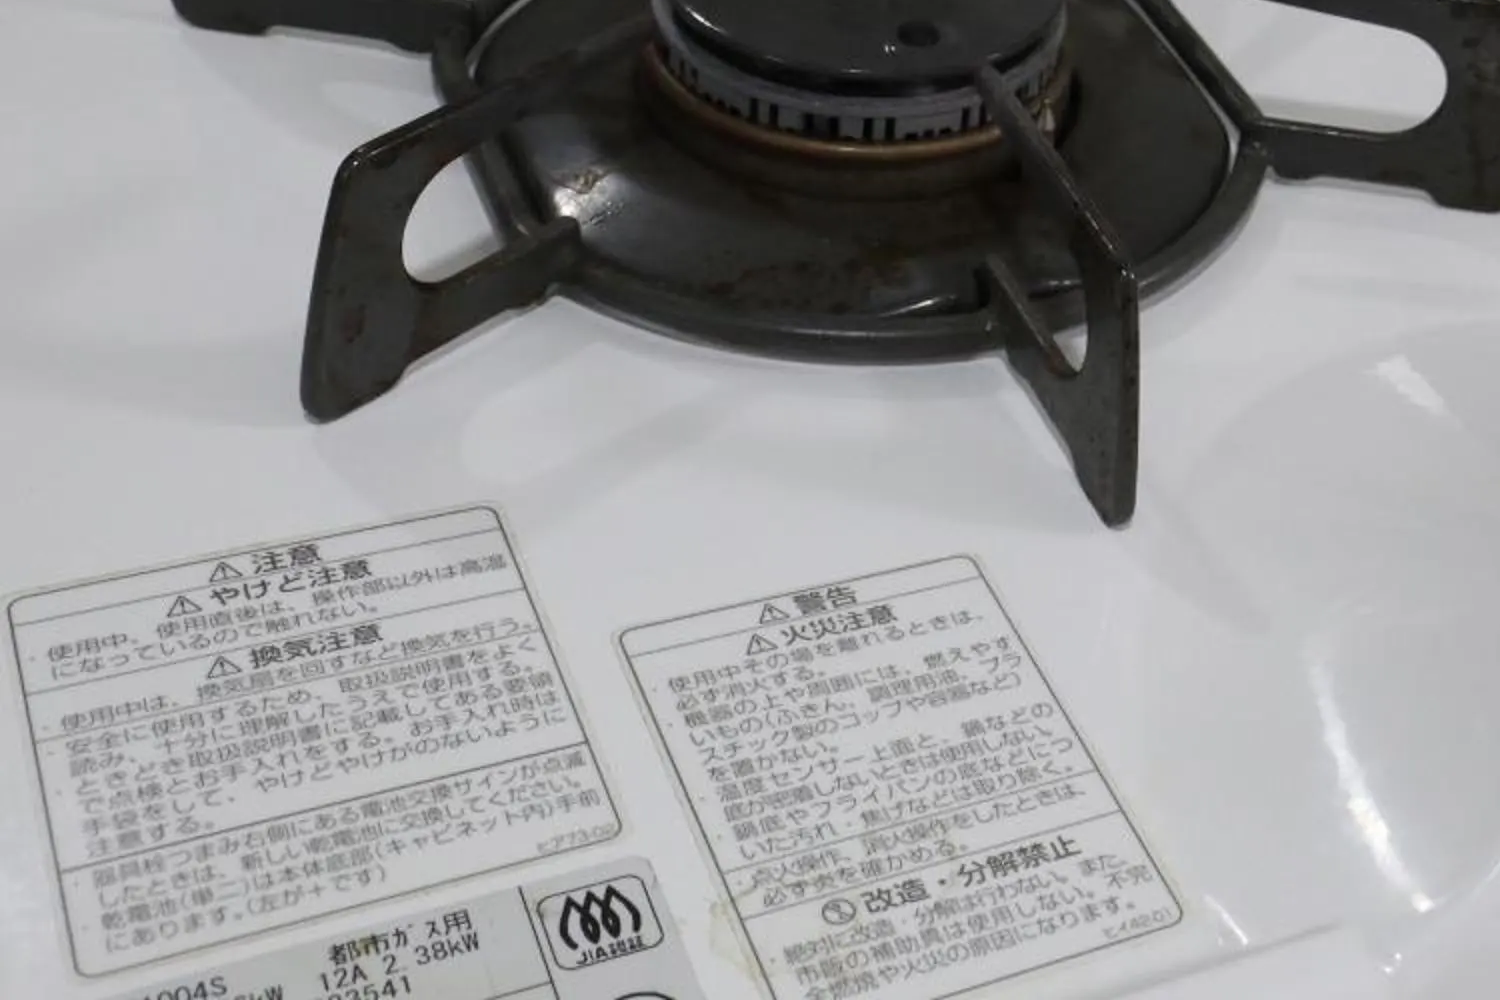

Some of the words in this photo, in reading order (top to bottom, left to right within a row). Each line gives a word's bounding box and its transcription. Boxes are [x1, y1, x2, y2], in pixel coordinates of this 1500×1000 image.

[251, 543, 323, 573] 注意
[209, 558, 372, 606] やけど注意
[793, 585, 859, 615] 警告
[779, 602, 898, 645] 火災注意
[247, 623, 384, 668] 換気注意
[860, 835, 1083, 914] 改造・分解禁止
[320, 965, 368, 991] 12A
